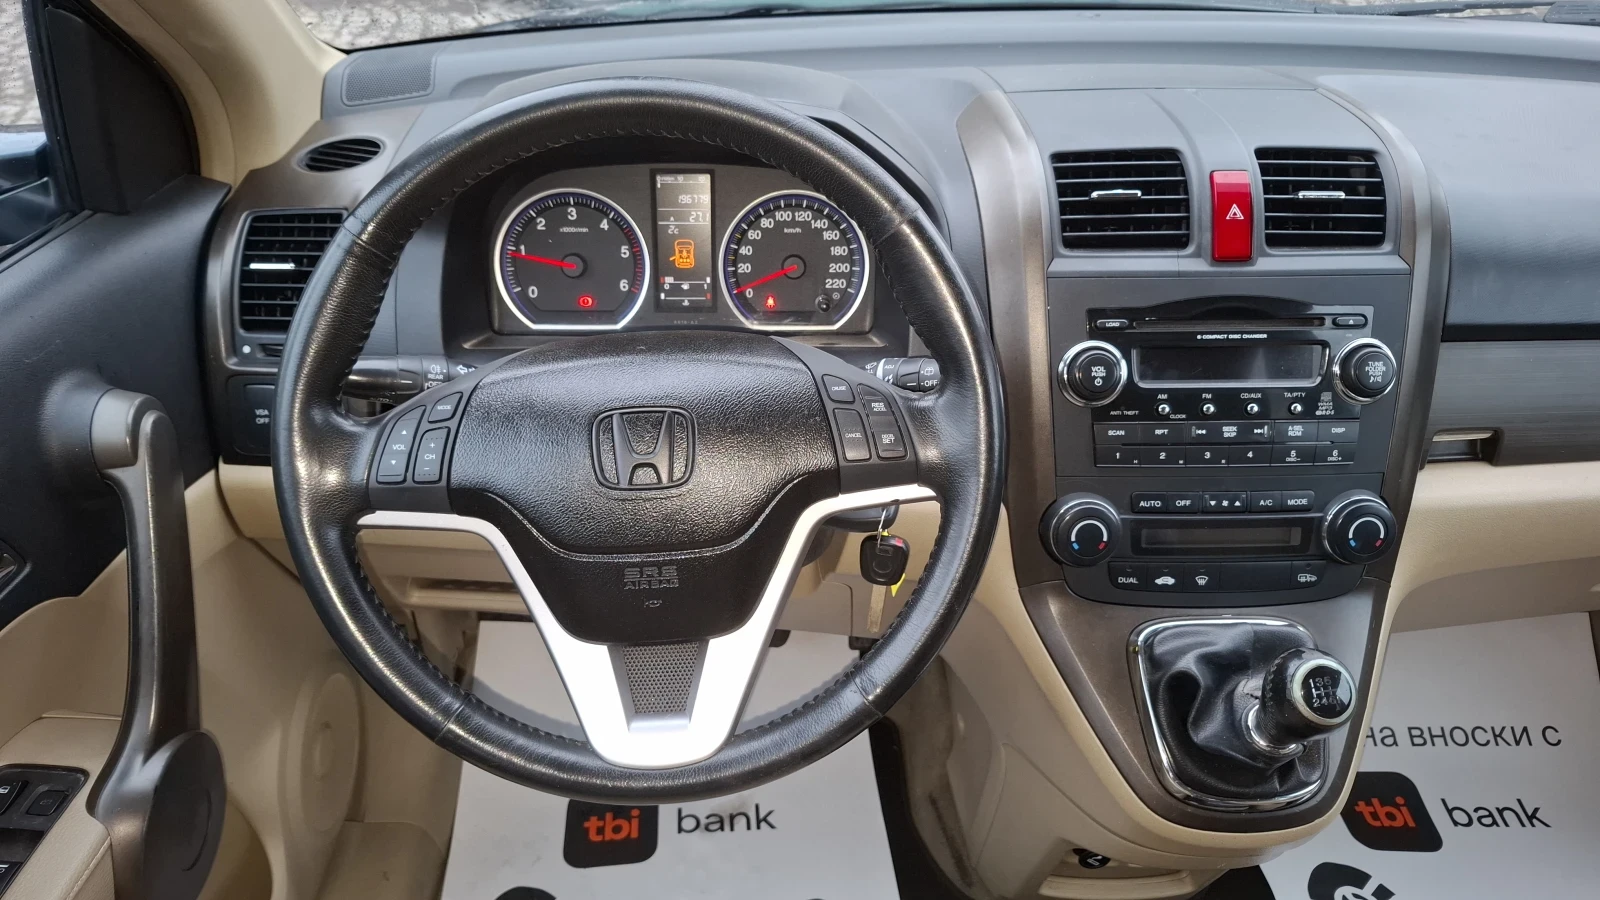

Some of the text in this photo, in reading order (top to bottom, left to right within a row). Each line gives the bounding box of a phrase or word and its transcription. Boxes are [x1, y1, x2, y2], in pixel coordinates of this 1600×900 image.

[678, 194, 709, 204] 196779
[567, 207, 577, 220] 3
[775, 211, 792, 221] 100
[794, 211, 812, 221] 120
[536, 218, 546, 230] 2
[600, 219, 609, 231] 4
[760, 219, 774, 229] 80
[811, 219, 828, 229] 140
[748, 231, 762, 240] 60
[822, 231, 840, 240] 160
[520, 244, 526, 256] 1
[620, 246, 630, 258] 5
[739, 246, 753, 256] 40
[830, 246, 848, 256] 180
[737, 263, 752, 273] 20
[829, 263, 850, 273] 200
[619, 279, 629, 291] 6
[825, 279, 847, 289] 220
[528, 286, 538, 298] 0
[745, 289, 754, 299] 0
[924, 380, 938, 388] OFF
[254, 408, 270, 416] VSA
[1115, 452, 1121, 460] 1
[1159, 452, 1166, 460] 2
[1204, 451, 1211, 459] 3
[1246, 450, 1254, 458] 4
[1290, 450, 1297, 458] 5
[1332, 449, 1339, 457] 6
[1139, 500, 1162, 508] AUTO
[1259, 499, 1273, 507] A/C
[1287, 498, 1308, 506] MODE
[623, 565, 679, 579] SRS
[623, 579, 680, 590] AIRBAG
[1117, 576, 1139, 584] DUAL
[1315, 677, 1324, 687] 3
[1312, 698, 1321, 708] 2
[1407, 725, 1533, 748] вноски
[1355, 796, 1552, 828] tbi bank
[583, 802, 777, 842] tbi bank
